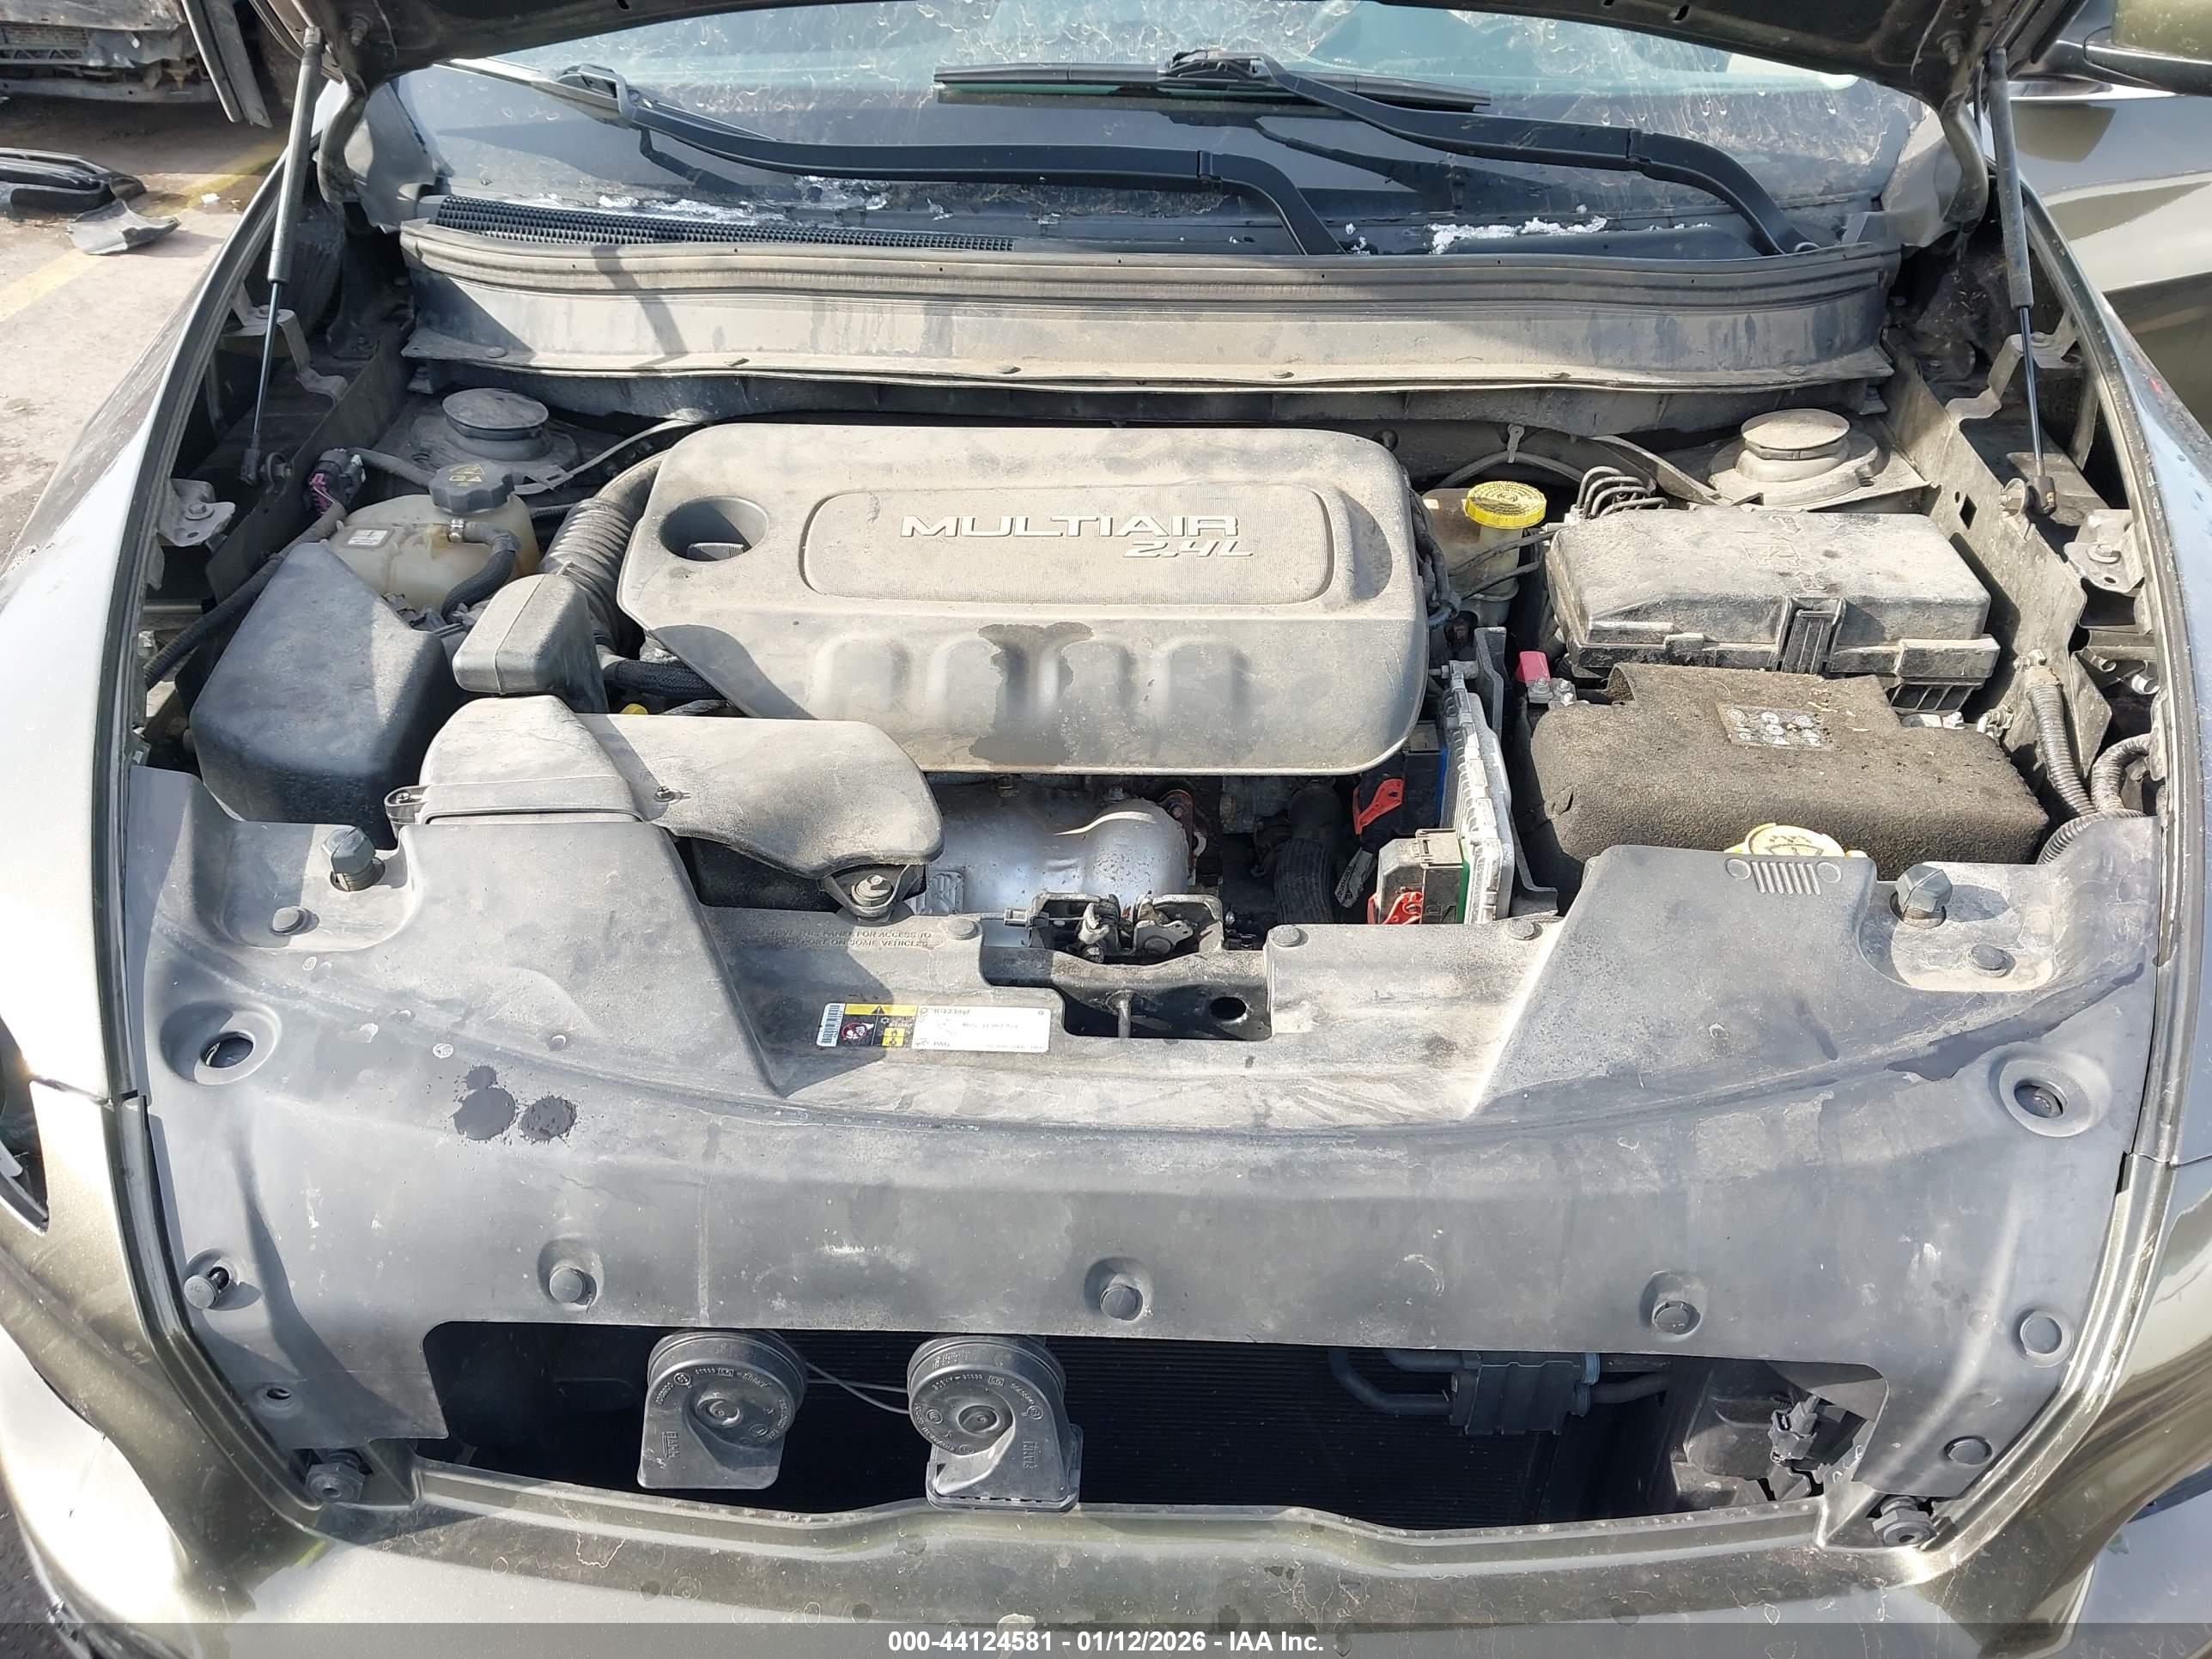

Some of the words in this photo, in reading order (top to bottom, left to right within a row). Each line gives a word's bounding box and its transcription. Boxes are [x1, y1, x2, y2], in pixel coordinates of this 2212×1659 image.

[900, 514, 1240, 538] MULTIAIR
[1122, 540, 1254, 558] 2.4L
[880, 939, 929, 948] VEHICLES
